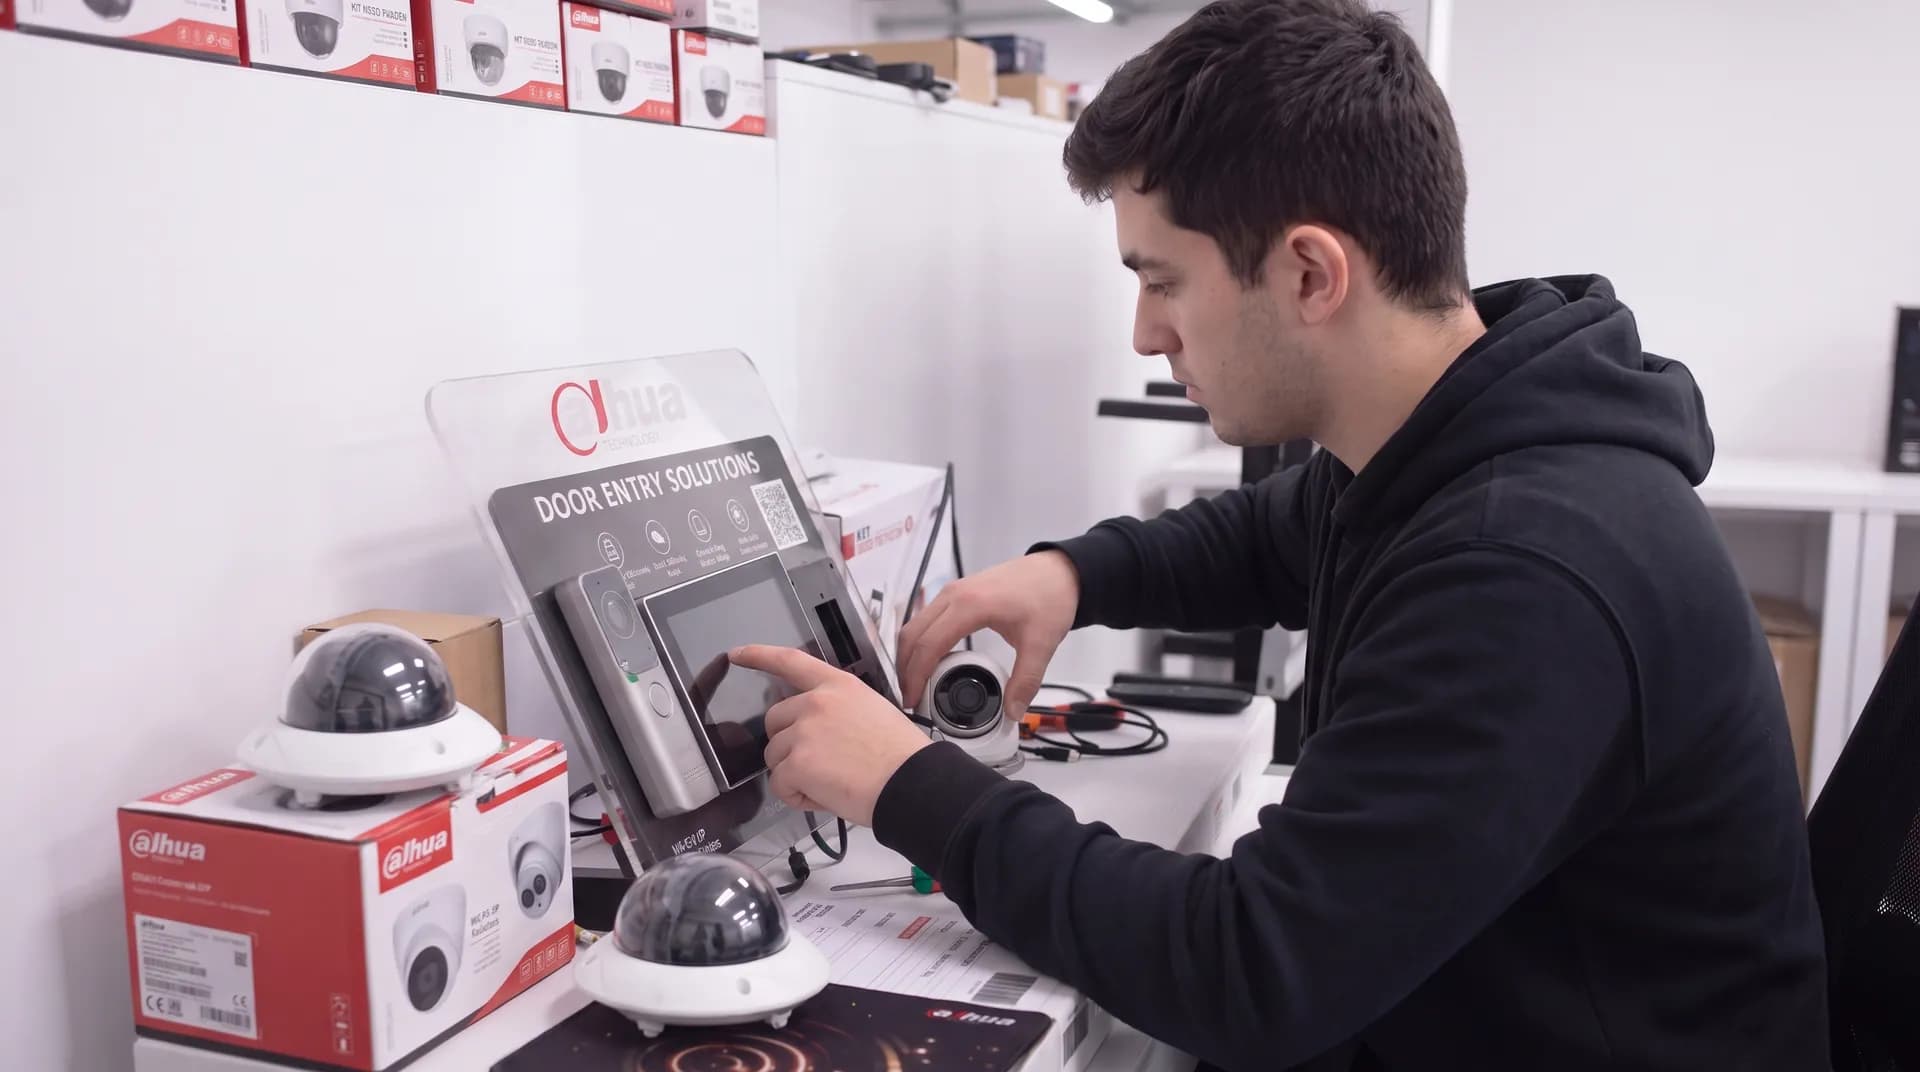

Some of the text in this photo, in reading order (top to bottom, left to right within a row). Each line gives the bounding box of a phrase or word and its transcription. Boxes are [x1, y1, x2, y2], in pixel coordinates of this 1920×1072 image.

[533, 451, 761, 524] DOOR ENTRY SOLUTIONS
